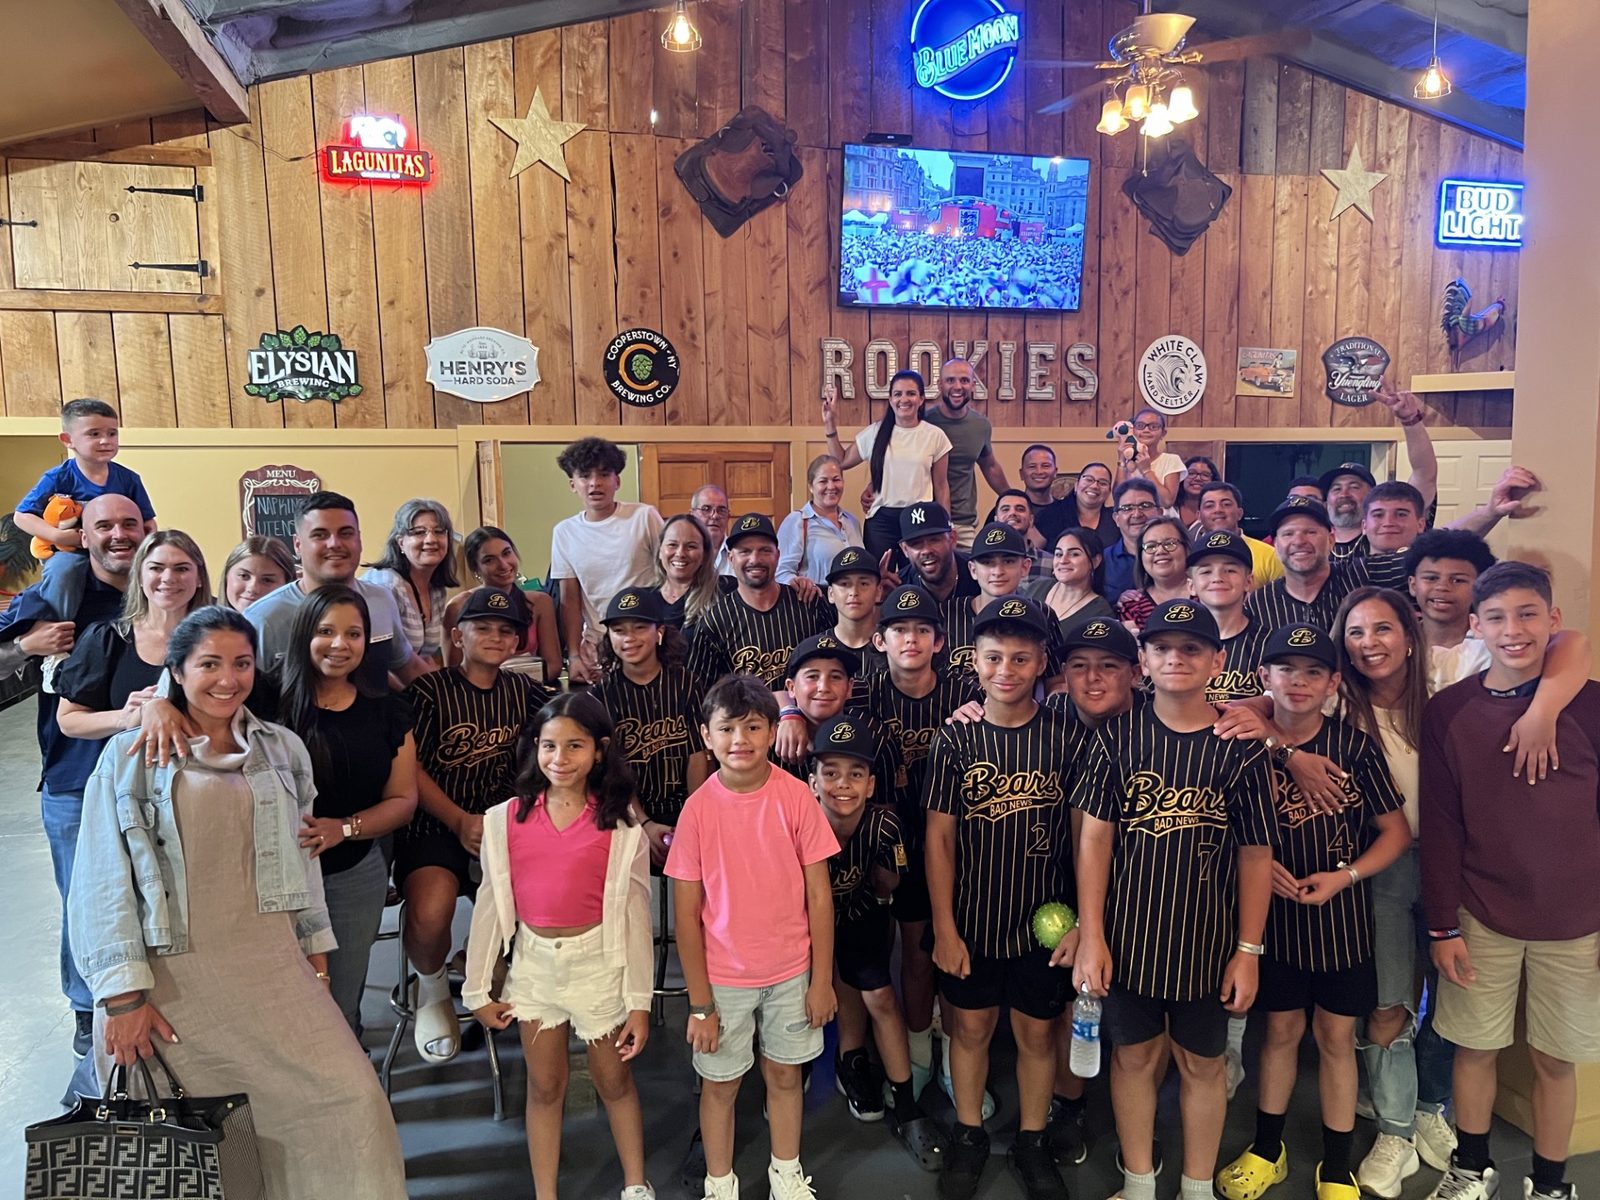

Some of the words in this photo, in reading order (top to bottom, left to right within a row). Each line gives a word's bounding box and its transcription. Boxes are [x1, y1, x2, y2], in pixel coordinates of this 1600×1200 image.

[916, 39, 969, 88] BLUE
[966, 15, 1019, 60] MOON
[331, 150, 425, 178] LAGUNITAS
[1456, 186, 1514, 213] BUD
[1443, 210, 1524, 240] LIGHT
[607, 331, 668, 360] COOPERSTOWN
[667, 355, 677, 369] NY
[1147, 340, 1184, 362] WHITE
[1185, 347, 1204, 385] CLAW
[1336, 342, 1382, 356] TRADITIONAL
[249, 351, 356, 384] ELYSIAN
[440, 361, 527, 376] HENRY'S
[454, 377, 484, 385] HARD
[486, 377, 515, 385] SODA
[820, 336, 1099, 401] ROOKIES
[1328, 370, 1382, 392] Yuengling
[277, 377, 330, 388] BREWING
[611, 380, 654, 403] BREWING
[1146, 371, 1159, 397] HARD
[1160, 390, 1194, 405] SELTZER
[1340, 392, 1368, 402] LAGER
[266, 470, 297, 478] MENU
[732, 646, 795, 676] Bear
[1206, 671, 1260, 697] ars
[1209, 693, 1230, 701] NEWS
[960, 762, 1064, 809] Bears
[1121, 771, 1228, 821] Bears
[990, 802, 1007, 817] BAD
[1009, 798, 1033, 811] NEWS
[1288, 808, 1307, 823] BAD
[1154, 817, 1174, 832] BAD
[1175, 815, 1201, 828] NEWS
[1027, 822, 1051, 857] 2
[1327, 823, 1352, 859] 4
[1197, 843, 1220, 881] 7
